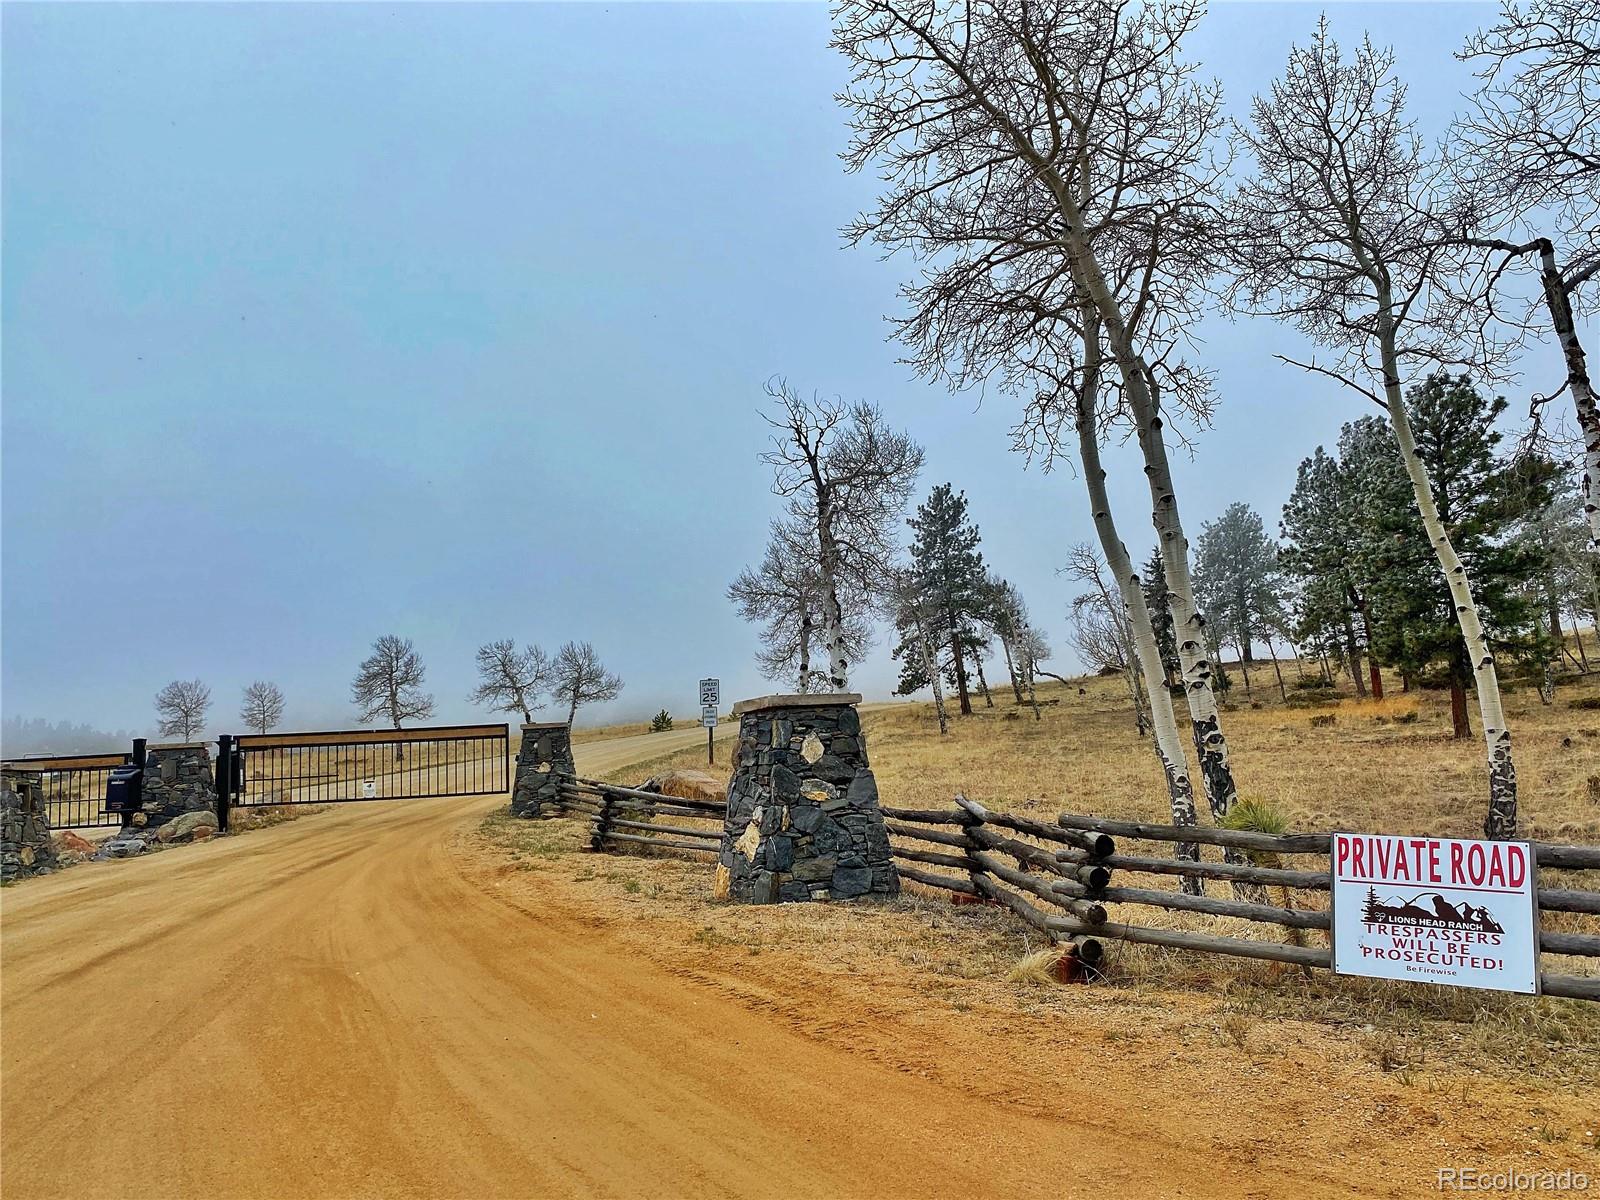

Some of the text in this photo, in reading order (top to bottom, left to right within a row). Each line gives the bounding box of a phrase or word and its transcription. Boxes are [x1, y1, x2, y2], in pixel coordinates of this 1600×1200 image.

[702, 692, 717, 702] 25
[1338, 837, 1526, 888] PRIVATE ROAD
[1388, 915, 1483, 931] LIONS HEAD RANCH
[1364, 923, 1501, 945] TRESPASSERS
[1392, 938, 1470, 955] WILL BE
[1363, 947, 1503, 971] PROSECUTED!
[1418, 966, 1458, 976] Firewise
